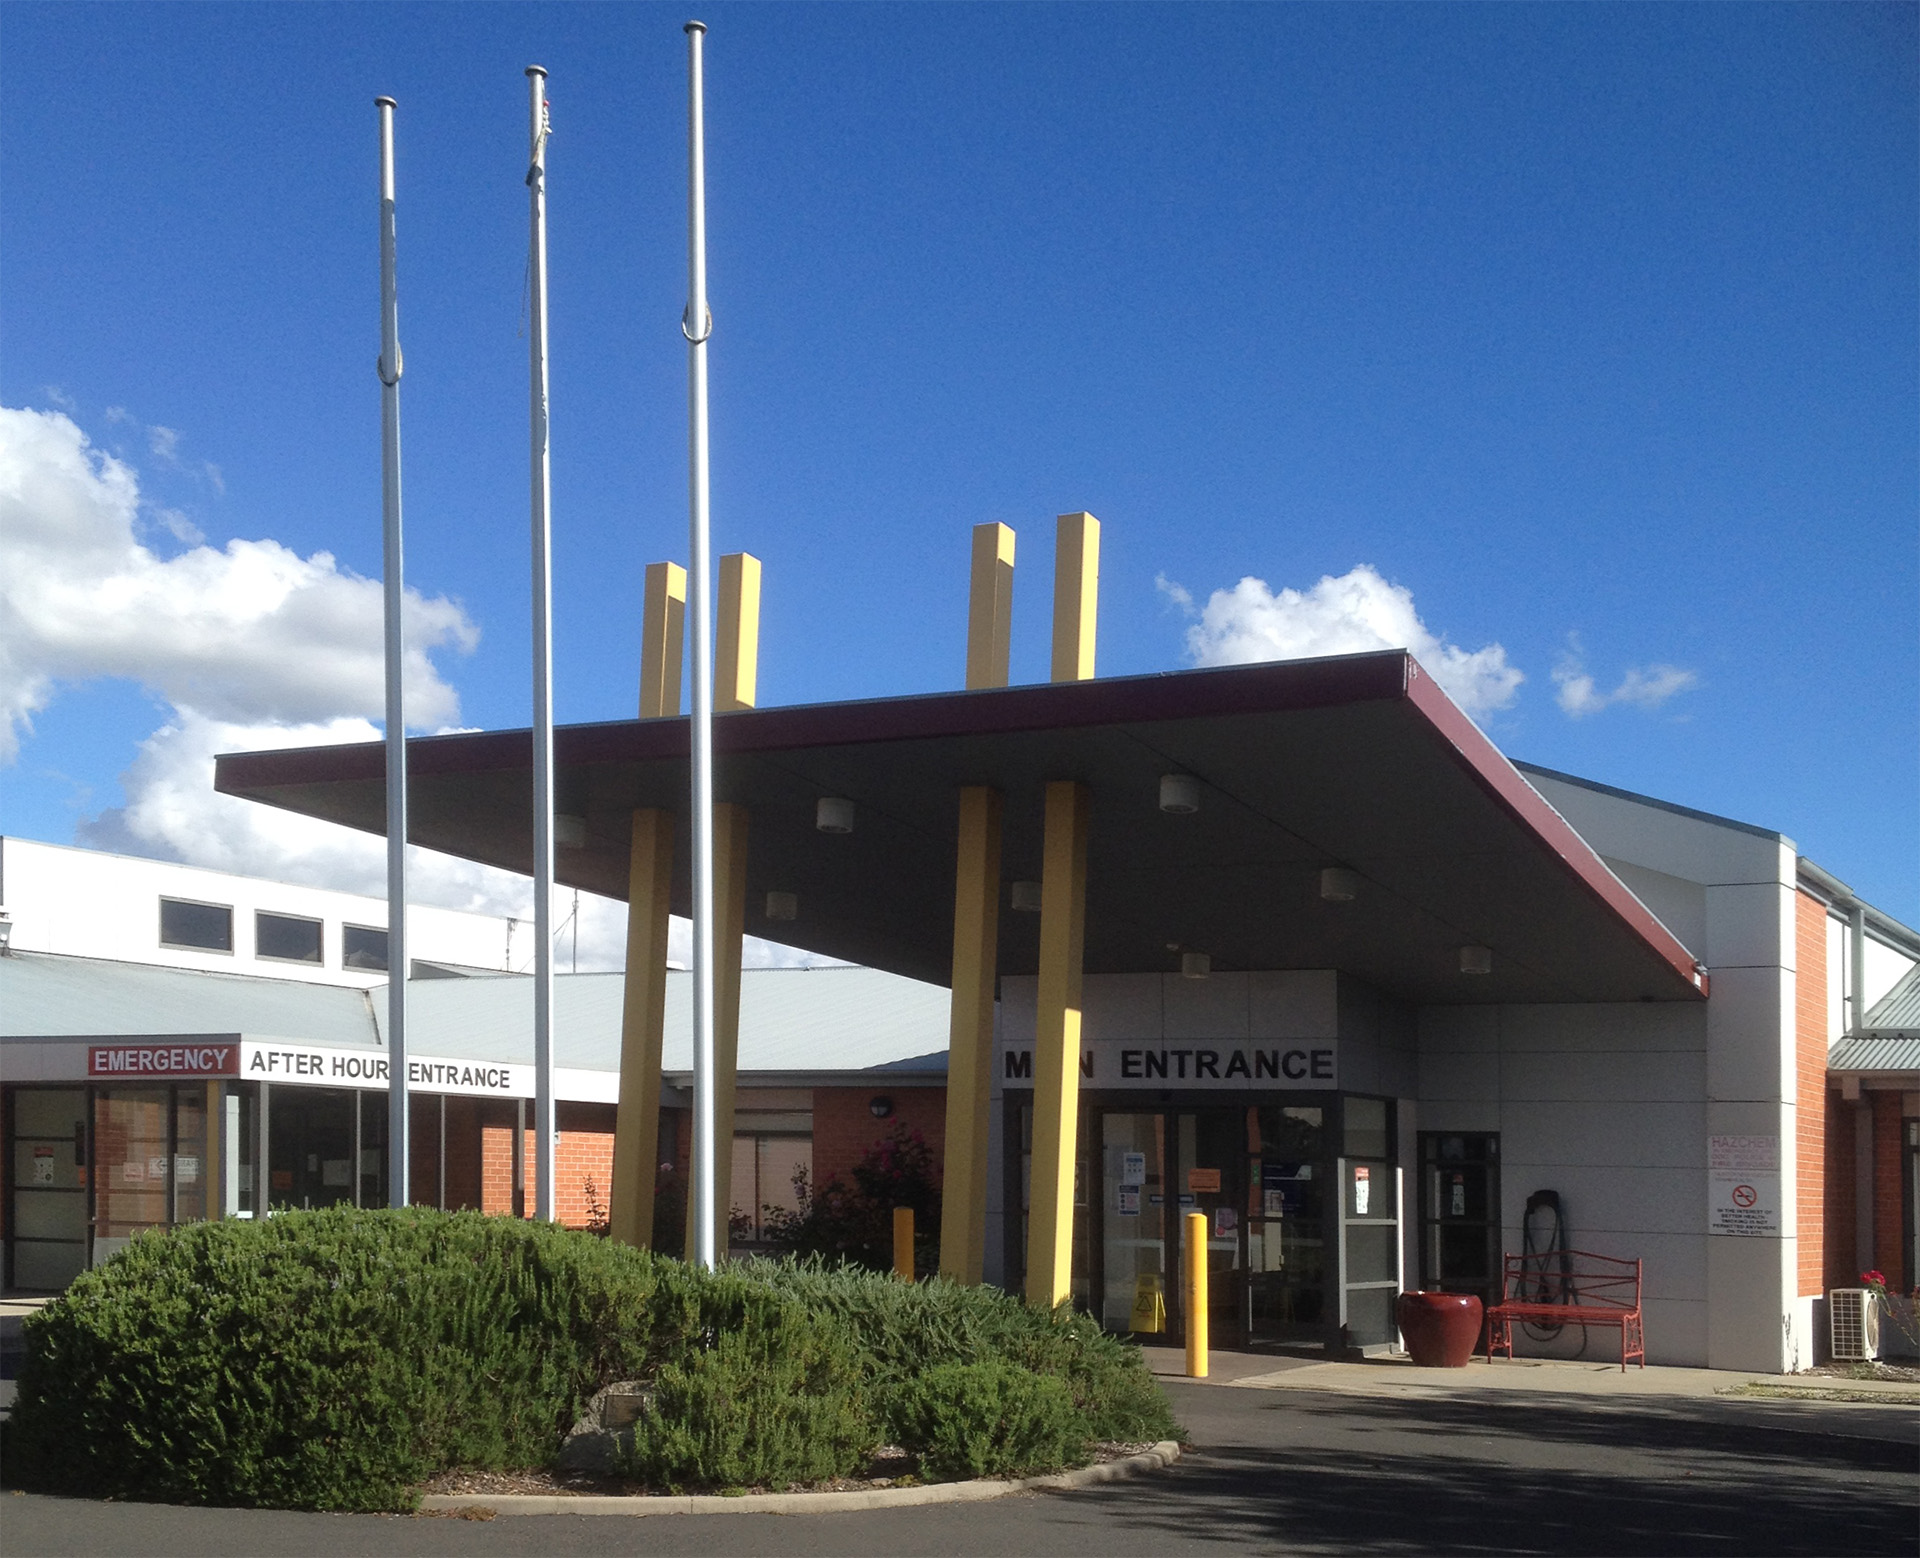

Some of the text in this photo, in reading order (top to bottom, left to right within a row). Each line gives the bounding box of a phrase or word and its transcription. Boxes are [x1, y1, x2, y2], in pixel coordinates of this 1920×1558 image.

[94, 1049, 228, 1071] EMERGENCY
[250, 1051, 511, 1088] AFTER HOUR ENTRANCE
[1005, 1050, 1334, 1079] MN ENTRANCE
[1711, 1136, 1776, 1148] HAZCHEM
